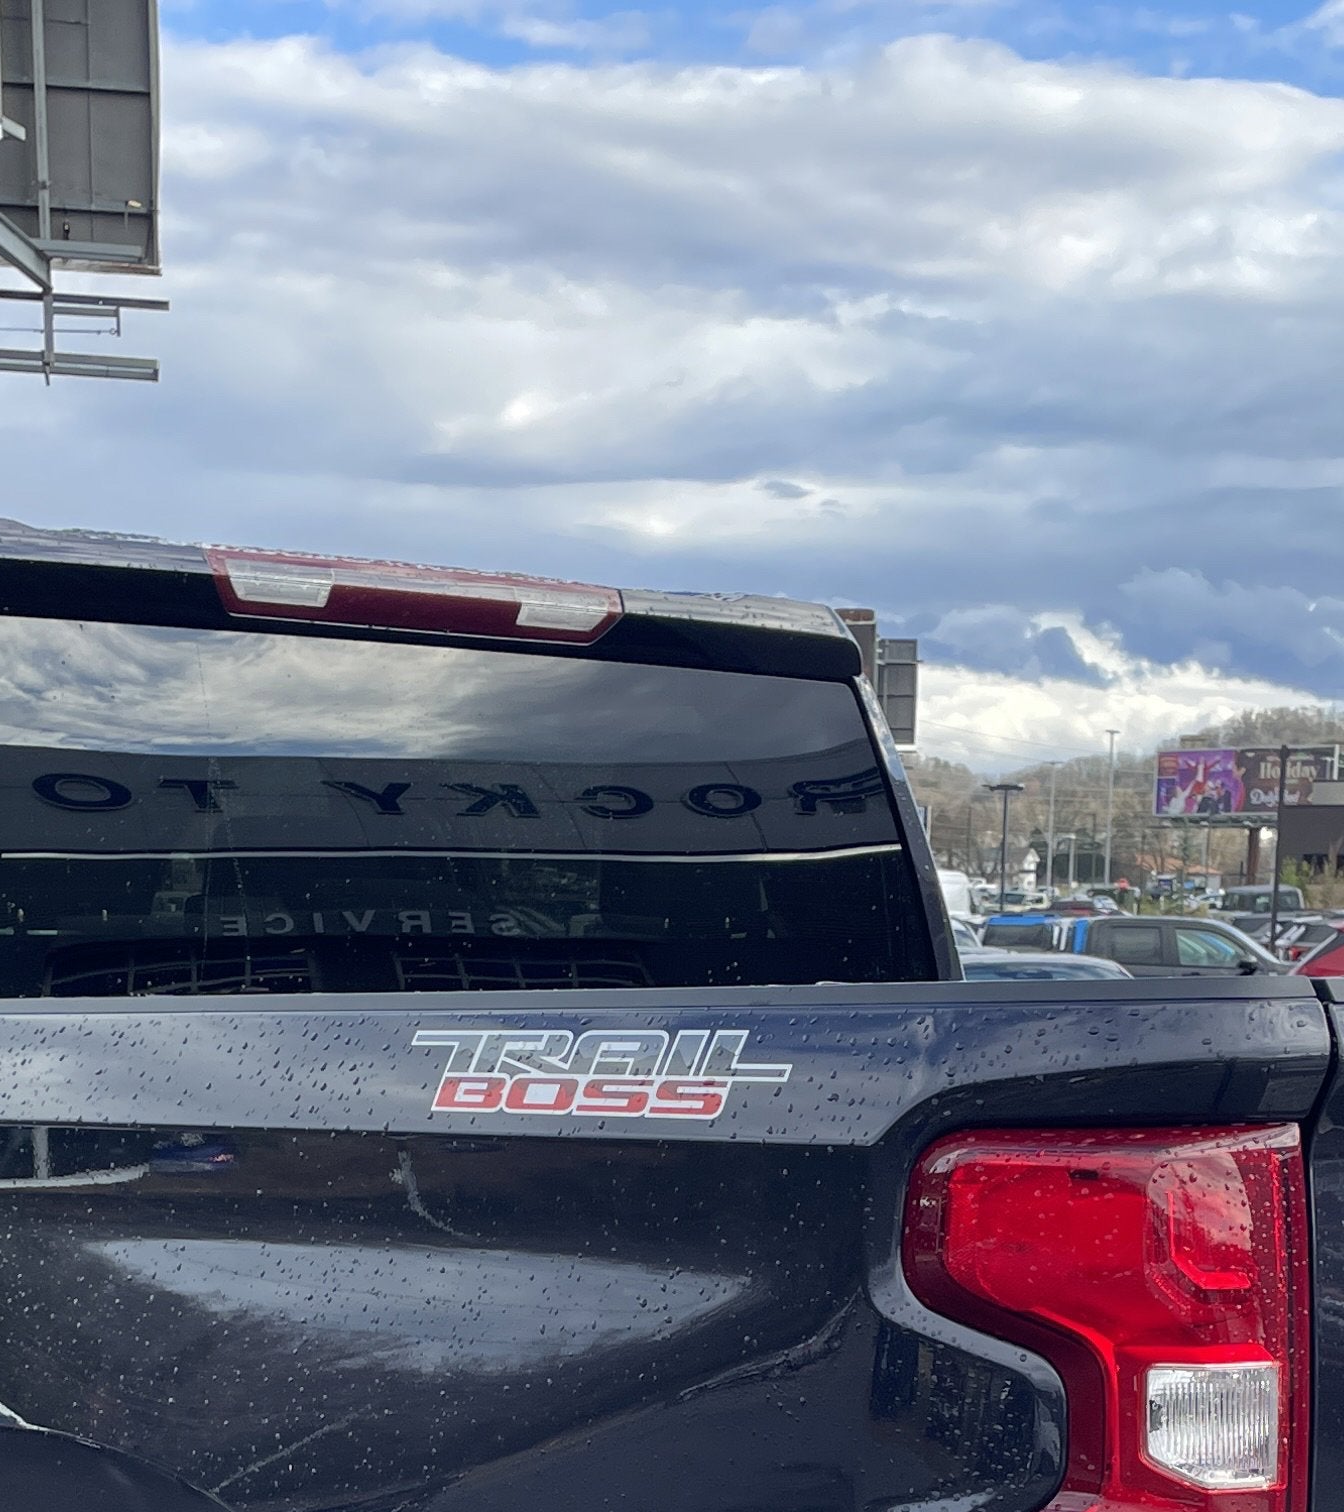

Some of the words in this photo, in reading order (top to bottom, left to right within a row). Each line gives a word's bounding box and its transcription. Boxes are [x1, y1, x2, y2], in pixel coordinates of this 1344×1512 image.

[1259, 761, 1320, 783] Hoiday
[411, 1029, 794, 1083] TRAIL
[431, 1075, 733, 1120] BOSS
